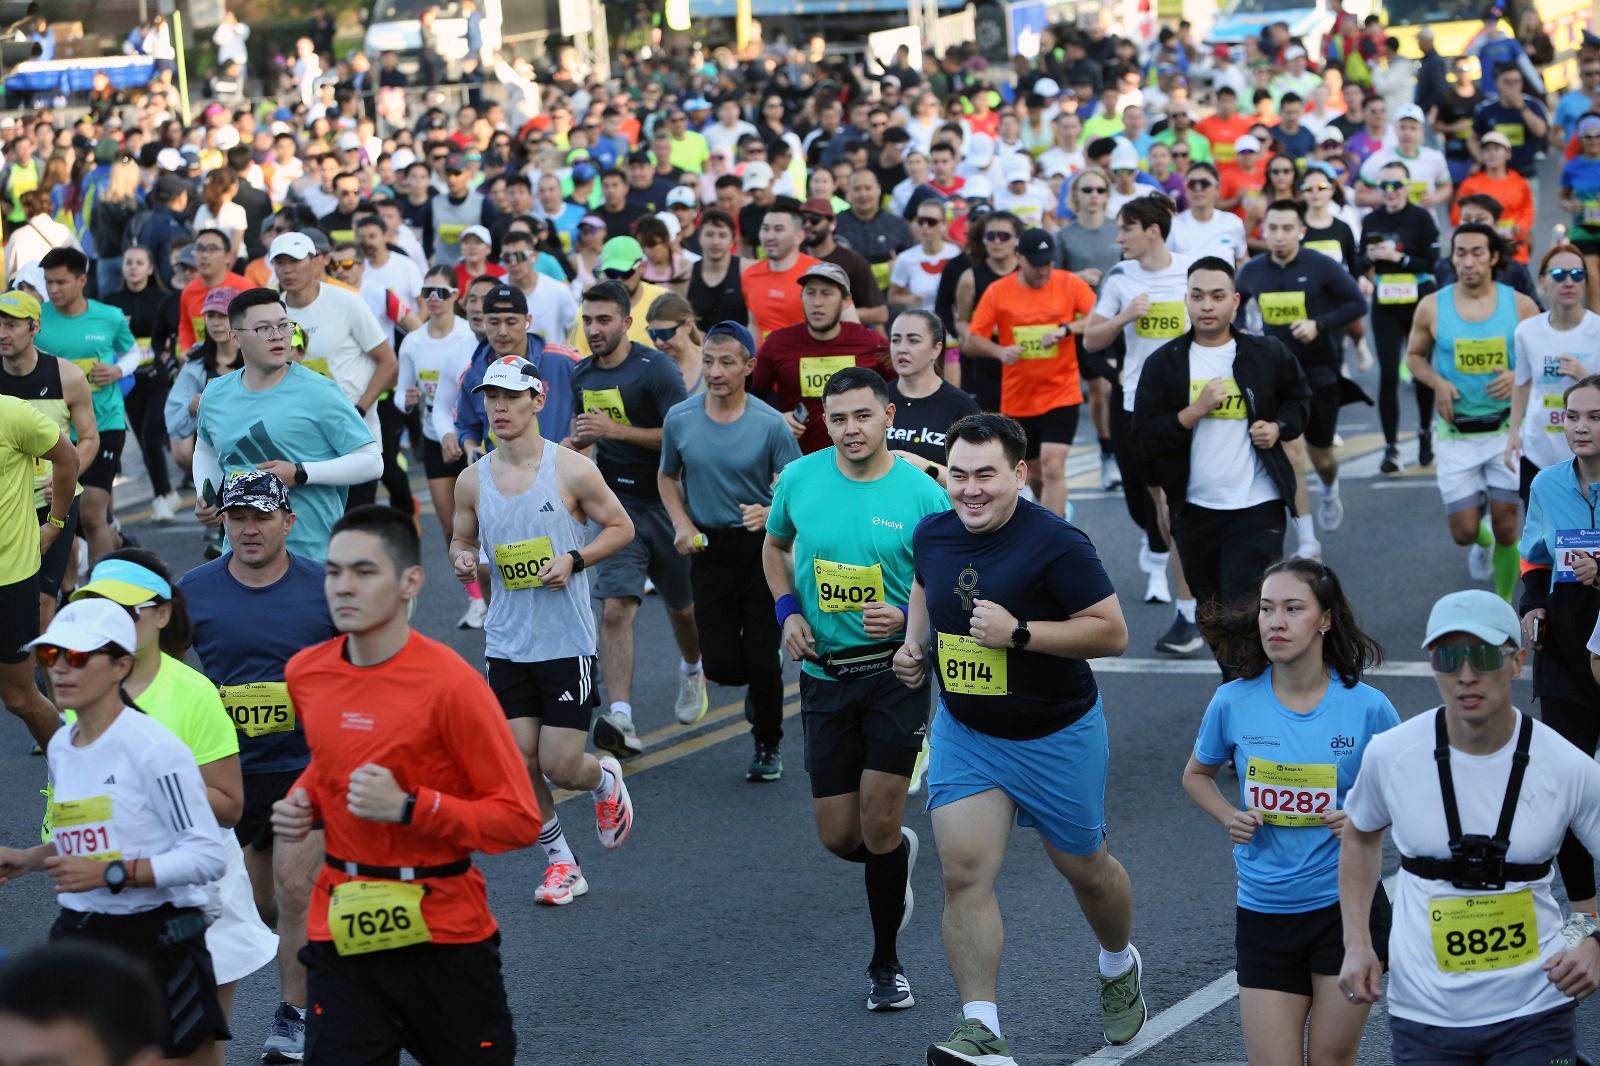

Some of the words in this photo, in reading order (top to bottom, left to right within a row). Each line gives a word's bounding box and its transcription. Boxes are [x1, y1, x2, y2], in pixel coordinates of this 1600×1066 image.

[1140, 316, 1180, 330] 8786
[1459, 352, 1504, 367] 10672
[1557, 535, 1564, 545] K
[816, 565, 822, 575] C
[820, 582, 878, 603] 9402
[939, 639, 944, 649] B
[849, 661, 889, 674] DEMIX
[946, 658, 993, 683] 8114
[226, 704, 288, 725] 10175
[1248, 765, 1257, 777] B
[1249, 786, 1331, 814] 10282
[341, 905, 411, 938] 7626
[1432, 909, 1443, 922] C
[1445, 922, 1527, 957] 8823
